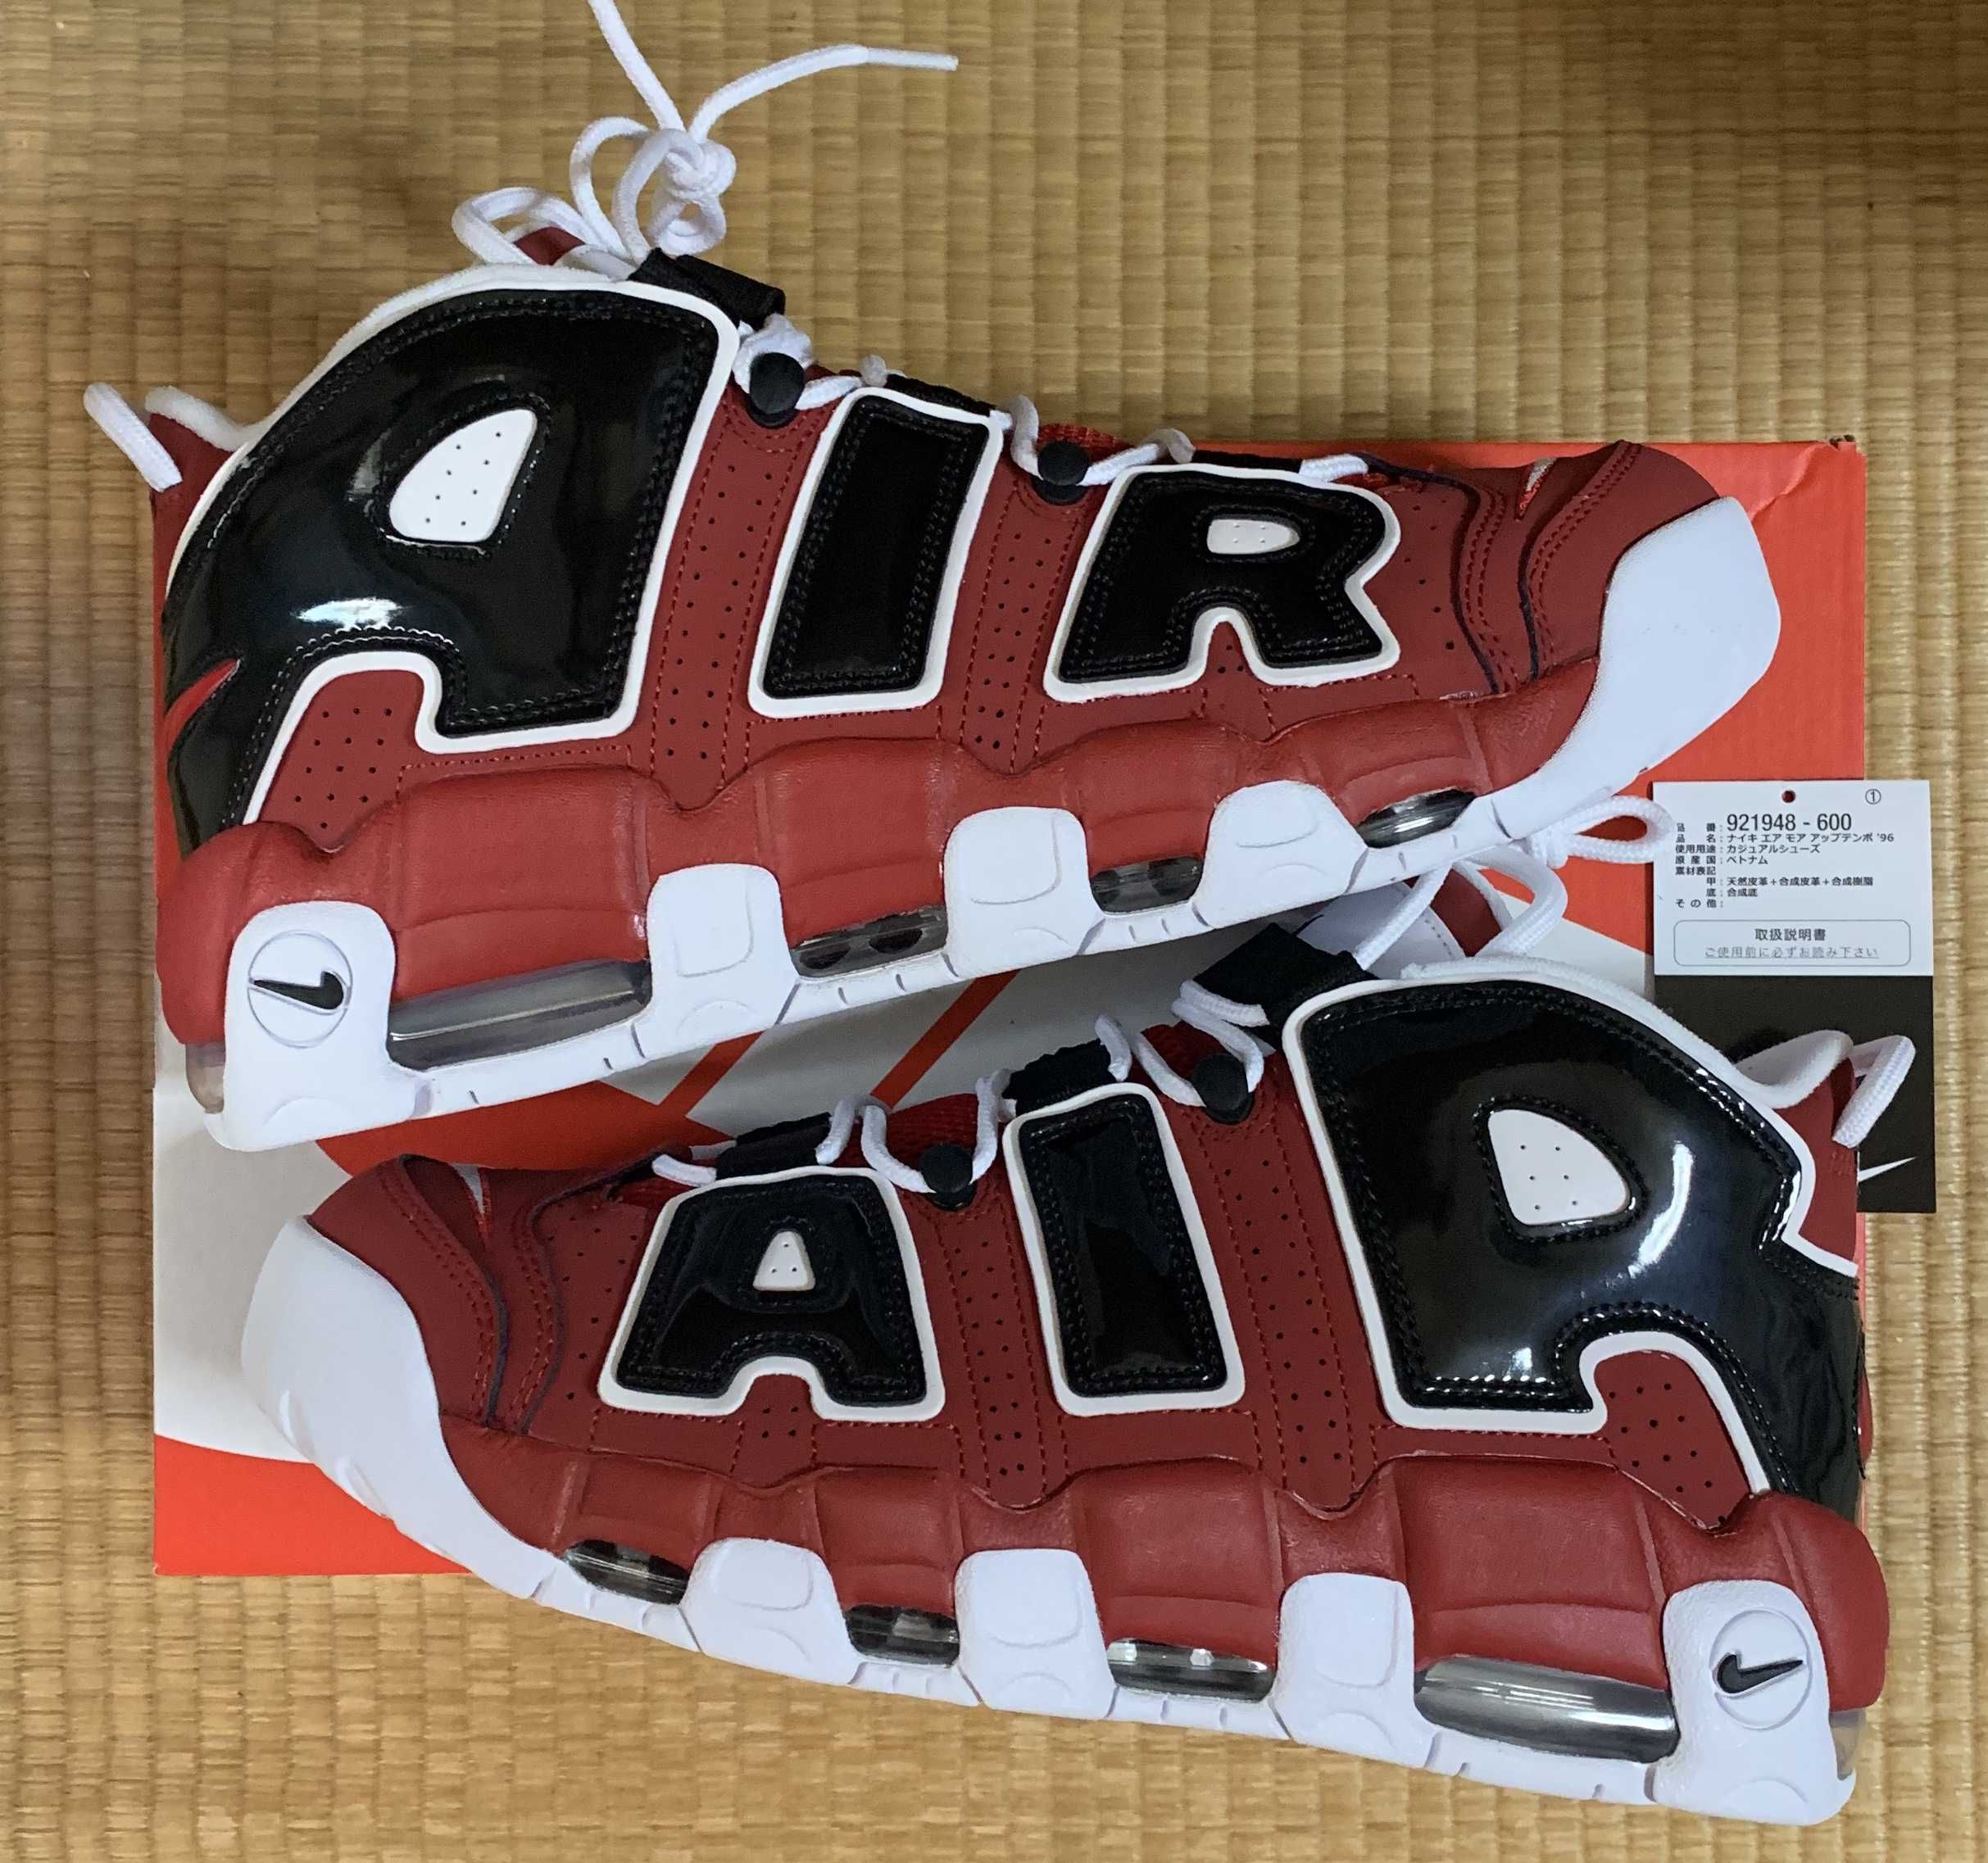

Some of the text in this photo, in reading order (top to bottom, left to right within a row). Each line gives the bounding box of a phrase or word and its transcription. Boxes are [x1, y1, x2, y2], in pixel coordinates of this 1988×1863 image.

[1817, 813, 1852, 831] 600
[1754, 928, 1826, 941] 取扱説明書
